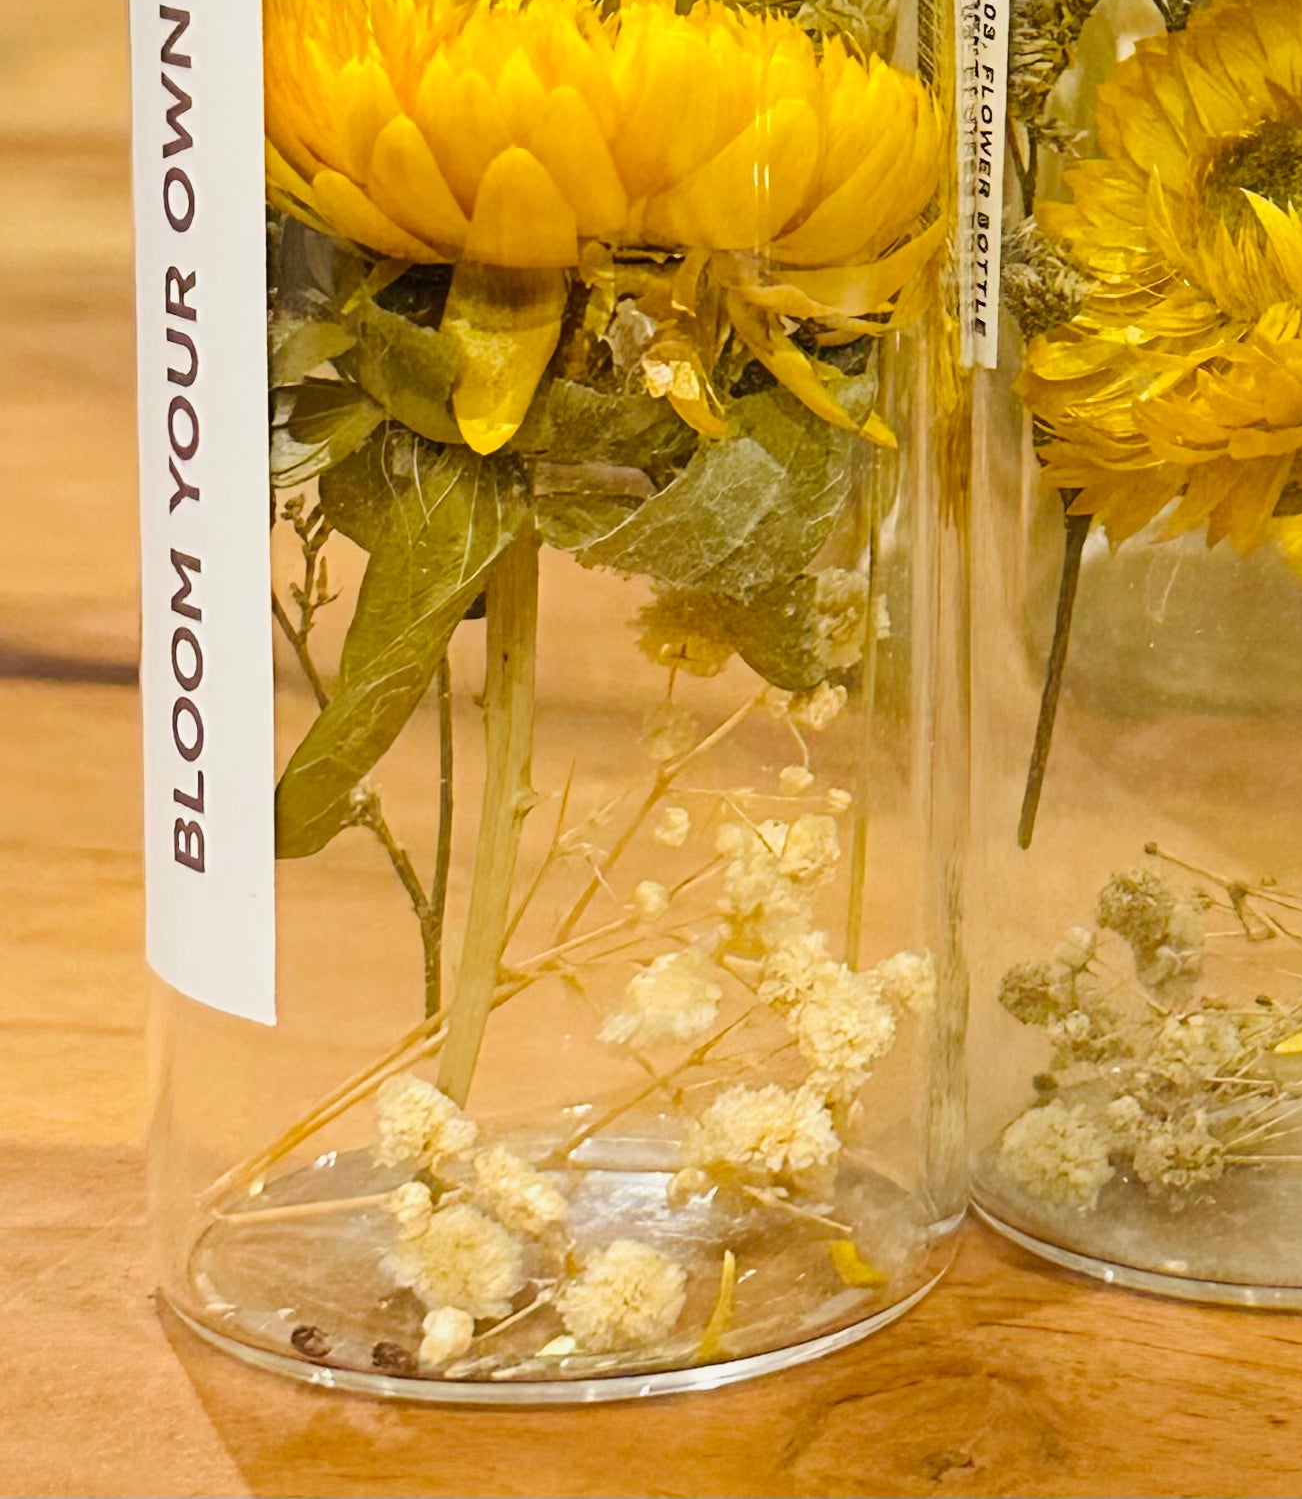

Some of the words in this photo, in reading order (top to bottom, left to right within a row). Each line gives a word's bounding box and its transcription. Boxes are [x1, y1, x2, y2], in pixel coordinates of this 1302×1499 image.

[159, 3, 195, 232] OWN
[978, 65, 995, 197] FLOWER
[975, 212, 991, 336] BOTTLE
[164, 264, 200, 515] YOUR
[169, 546, 205, 874] BLOOM
